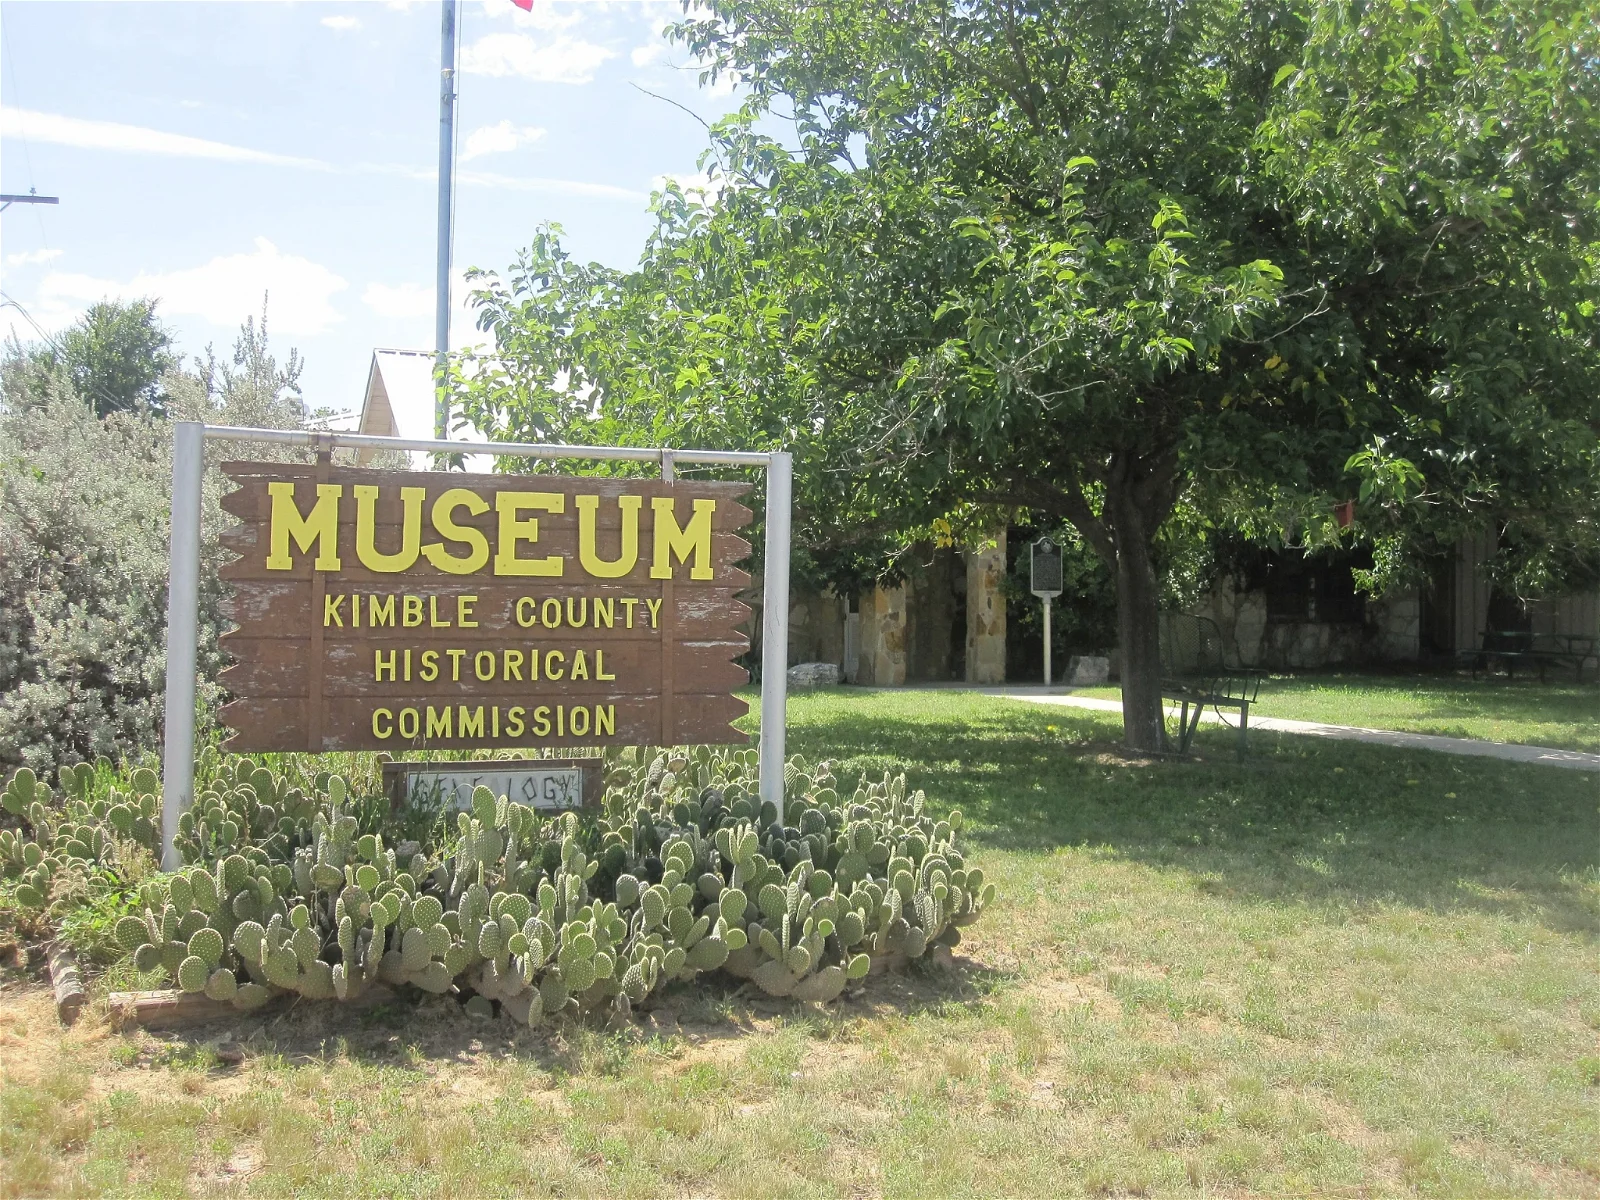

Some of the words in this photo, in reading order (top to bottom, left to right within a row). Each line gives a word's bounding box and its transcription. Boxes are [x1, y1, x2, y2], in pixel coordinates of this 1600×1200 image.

[266, 482, 716, 580] MUSEUM
[323, 594, 479, 627] KIMBLE
[516, 596, 663, 629] COUNTY
[374, 649, 616, 682] HISTORICAL
[371, 704, 616, 739] COMMISSION
[417, 775, 574, 804] GENLOGY
